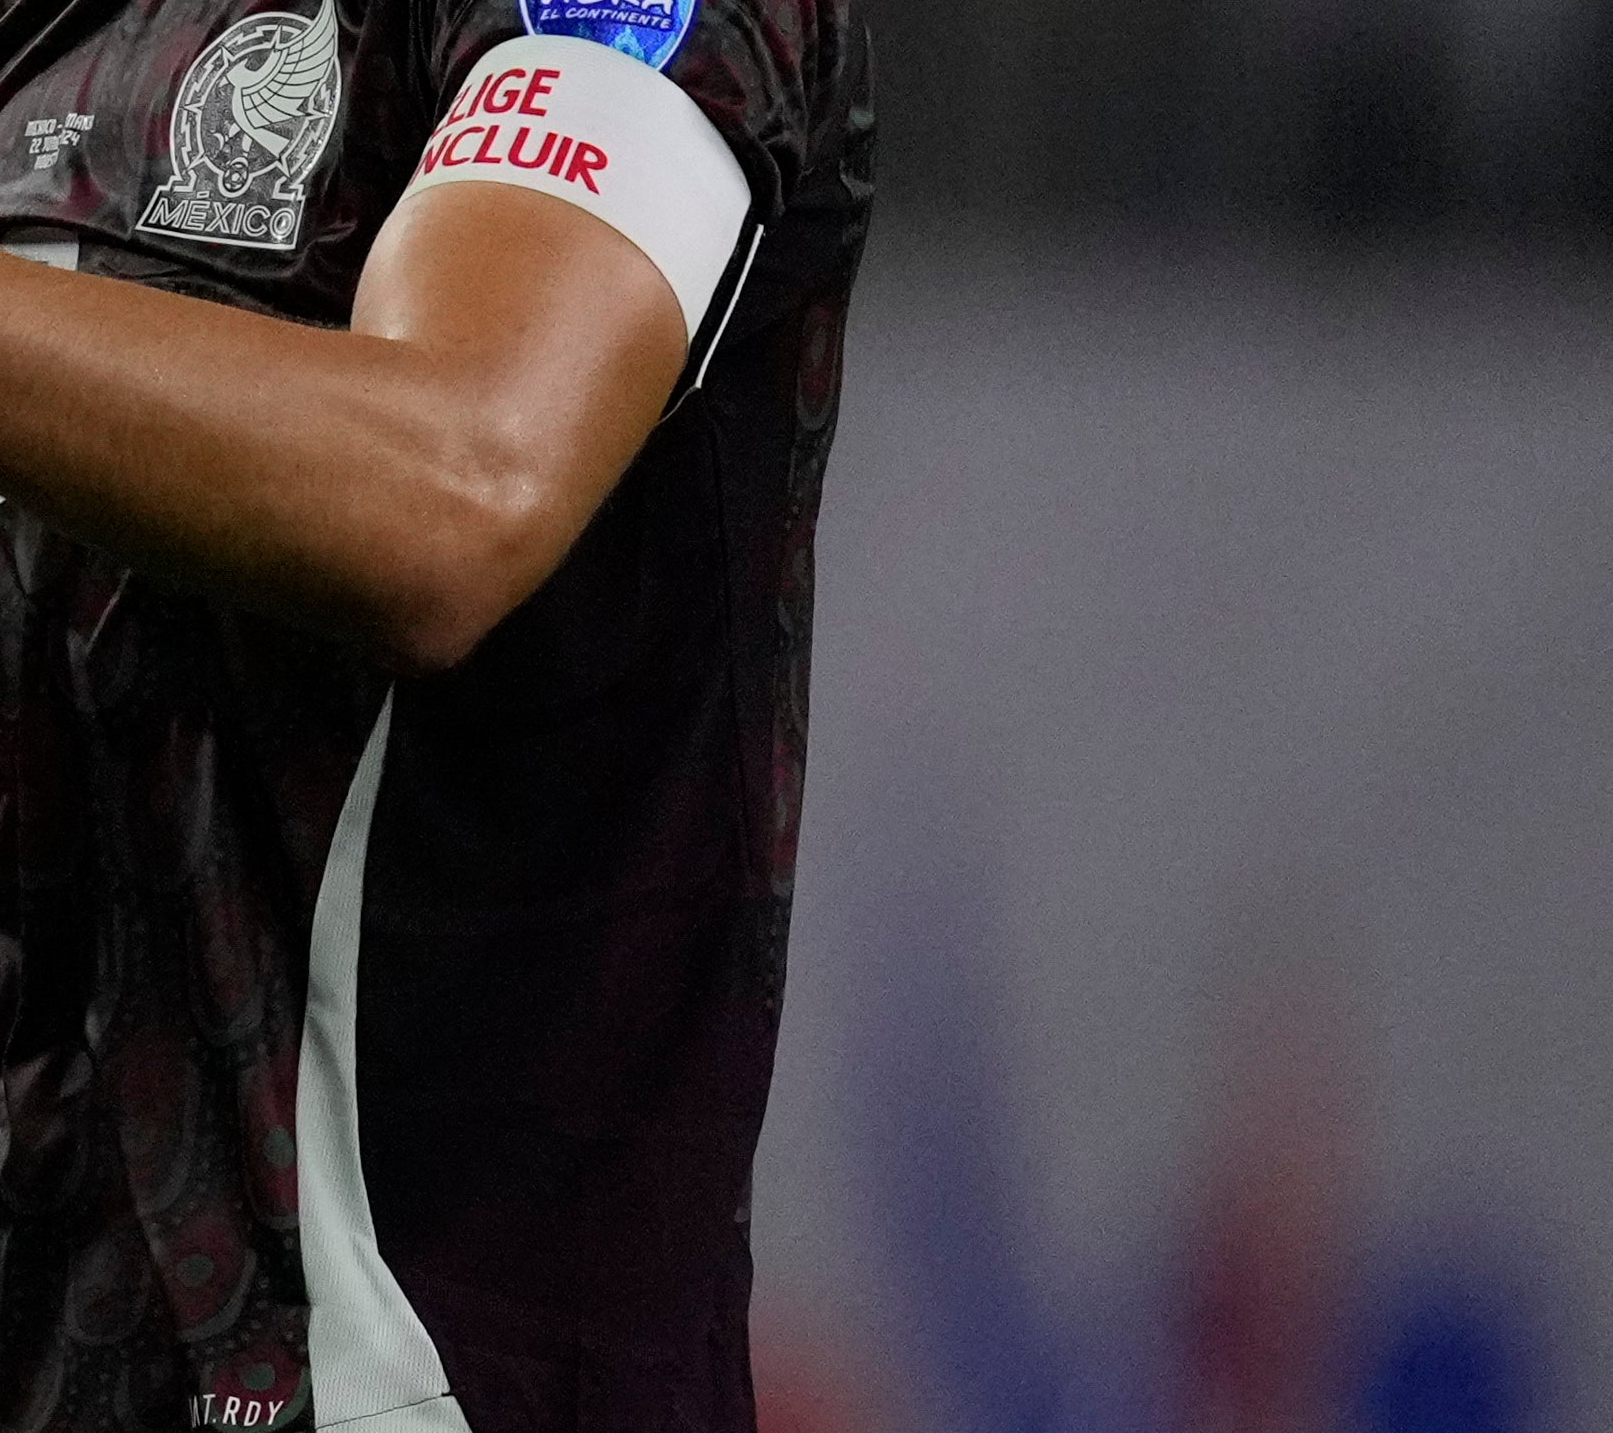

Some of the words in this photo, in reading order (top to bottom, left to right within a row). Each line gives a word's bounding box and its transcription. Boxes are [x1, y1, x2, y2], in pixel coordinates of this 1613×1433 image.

[540, 8, 561, 21] EL
[564, 7, 672, 29] CONTINENTE
[151, 190, 296, 238] MÉXICO
